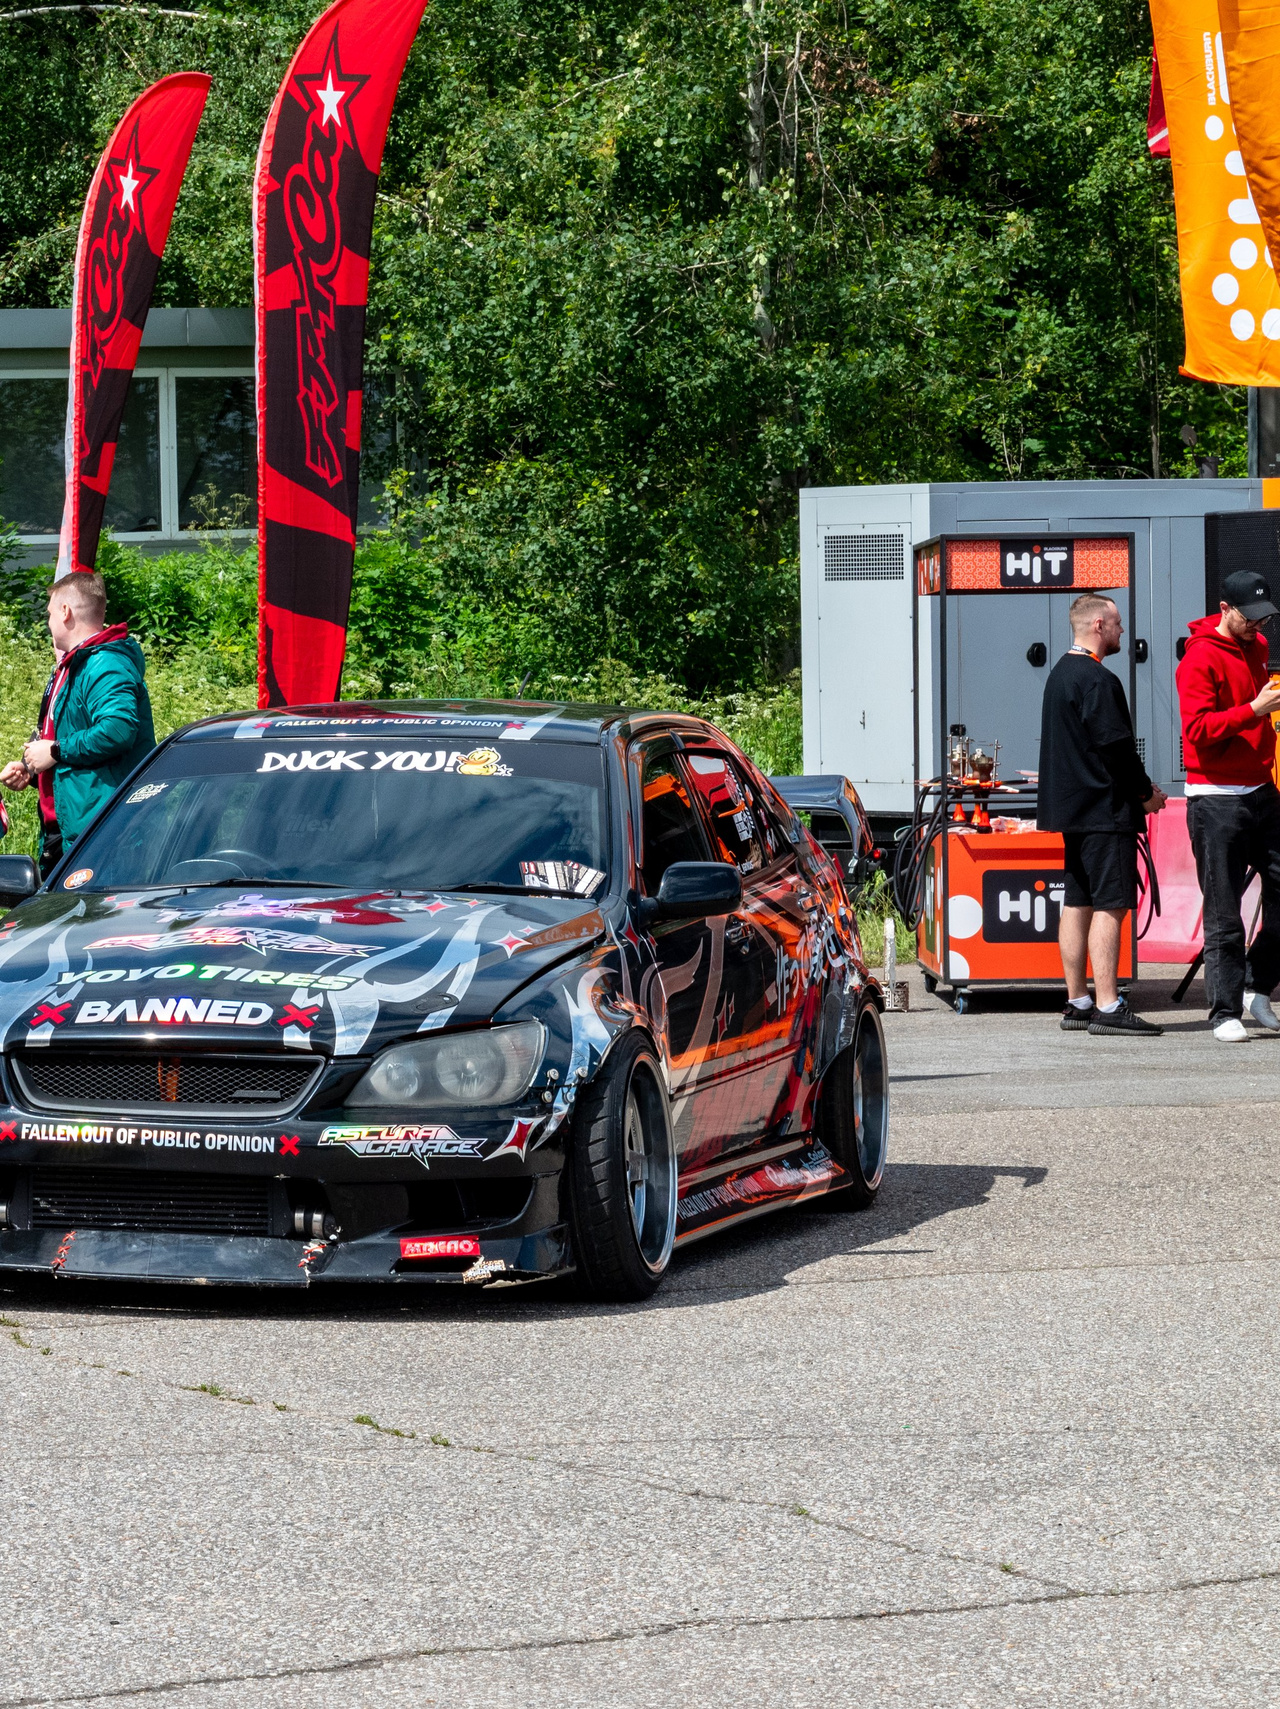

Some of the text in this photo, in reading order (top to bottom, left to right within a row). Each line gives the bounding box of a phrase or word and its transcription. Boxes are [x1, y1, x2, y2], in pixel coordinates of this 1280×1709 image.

[1203, 31, 1217, 106] BLACKBURN
[1006, 545, 1068, 584] HiT
[275, 718, 504, 728] FALLEN OUT OF PUBLIC OPINION
[256, 750, 462, 773] DUCK YOU!
[74, 997, 275, 1026] BANNED
[20, 1123, 275, 1153] FALLEN OUT OF PUBLIC OPINION
[321, 1126, 436, 1142] ASCURA
[363, 1140, 480, 1156] GARAGE
